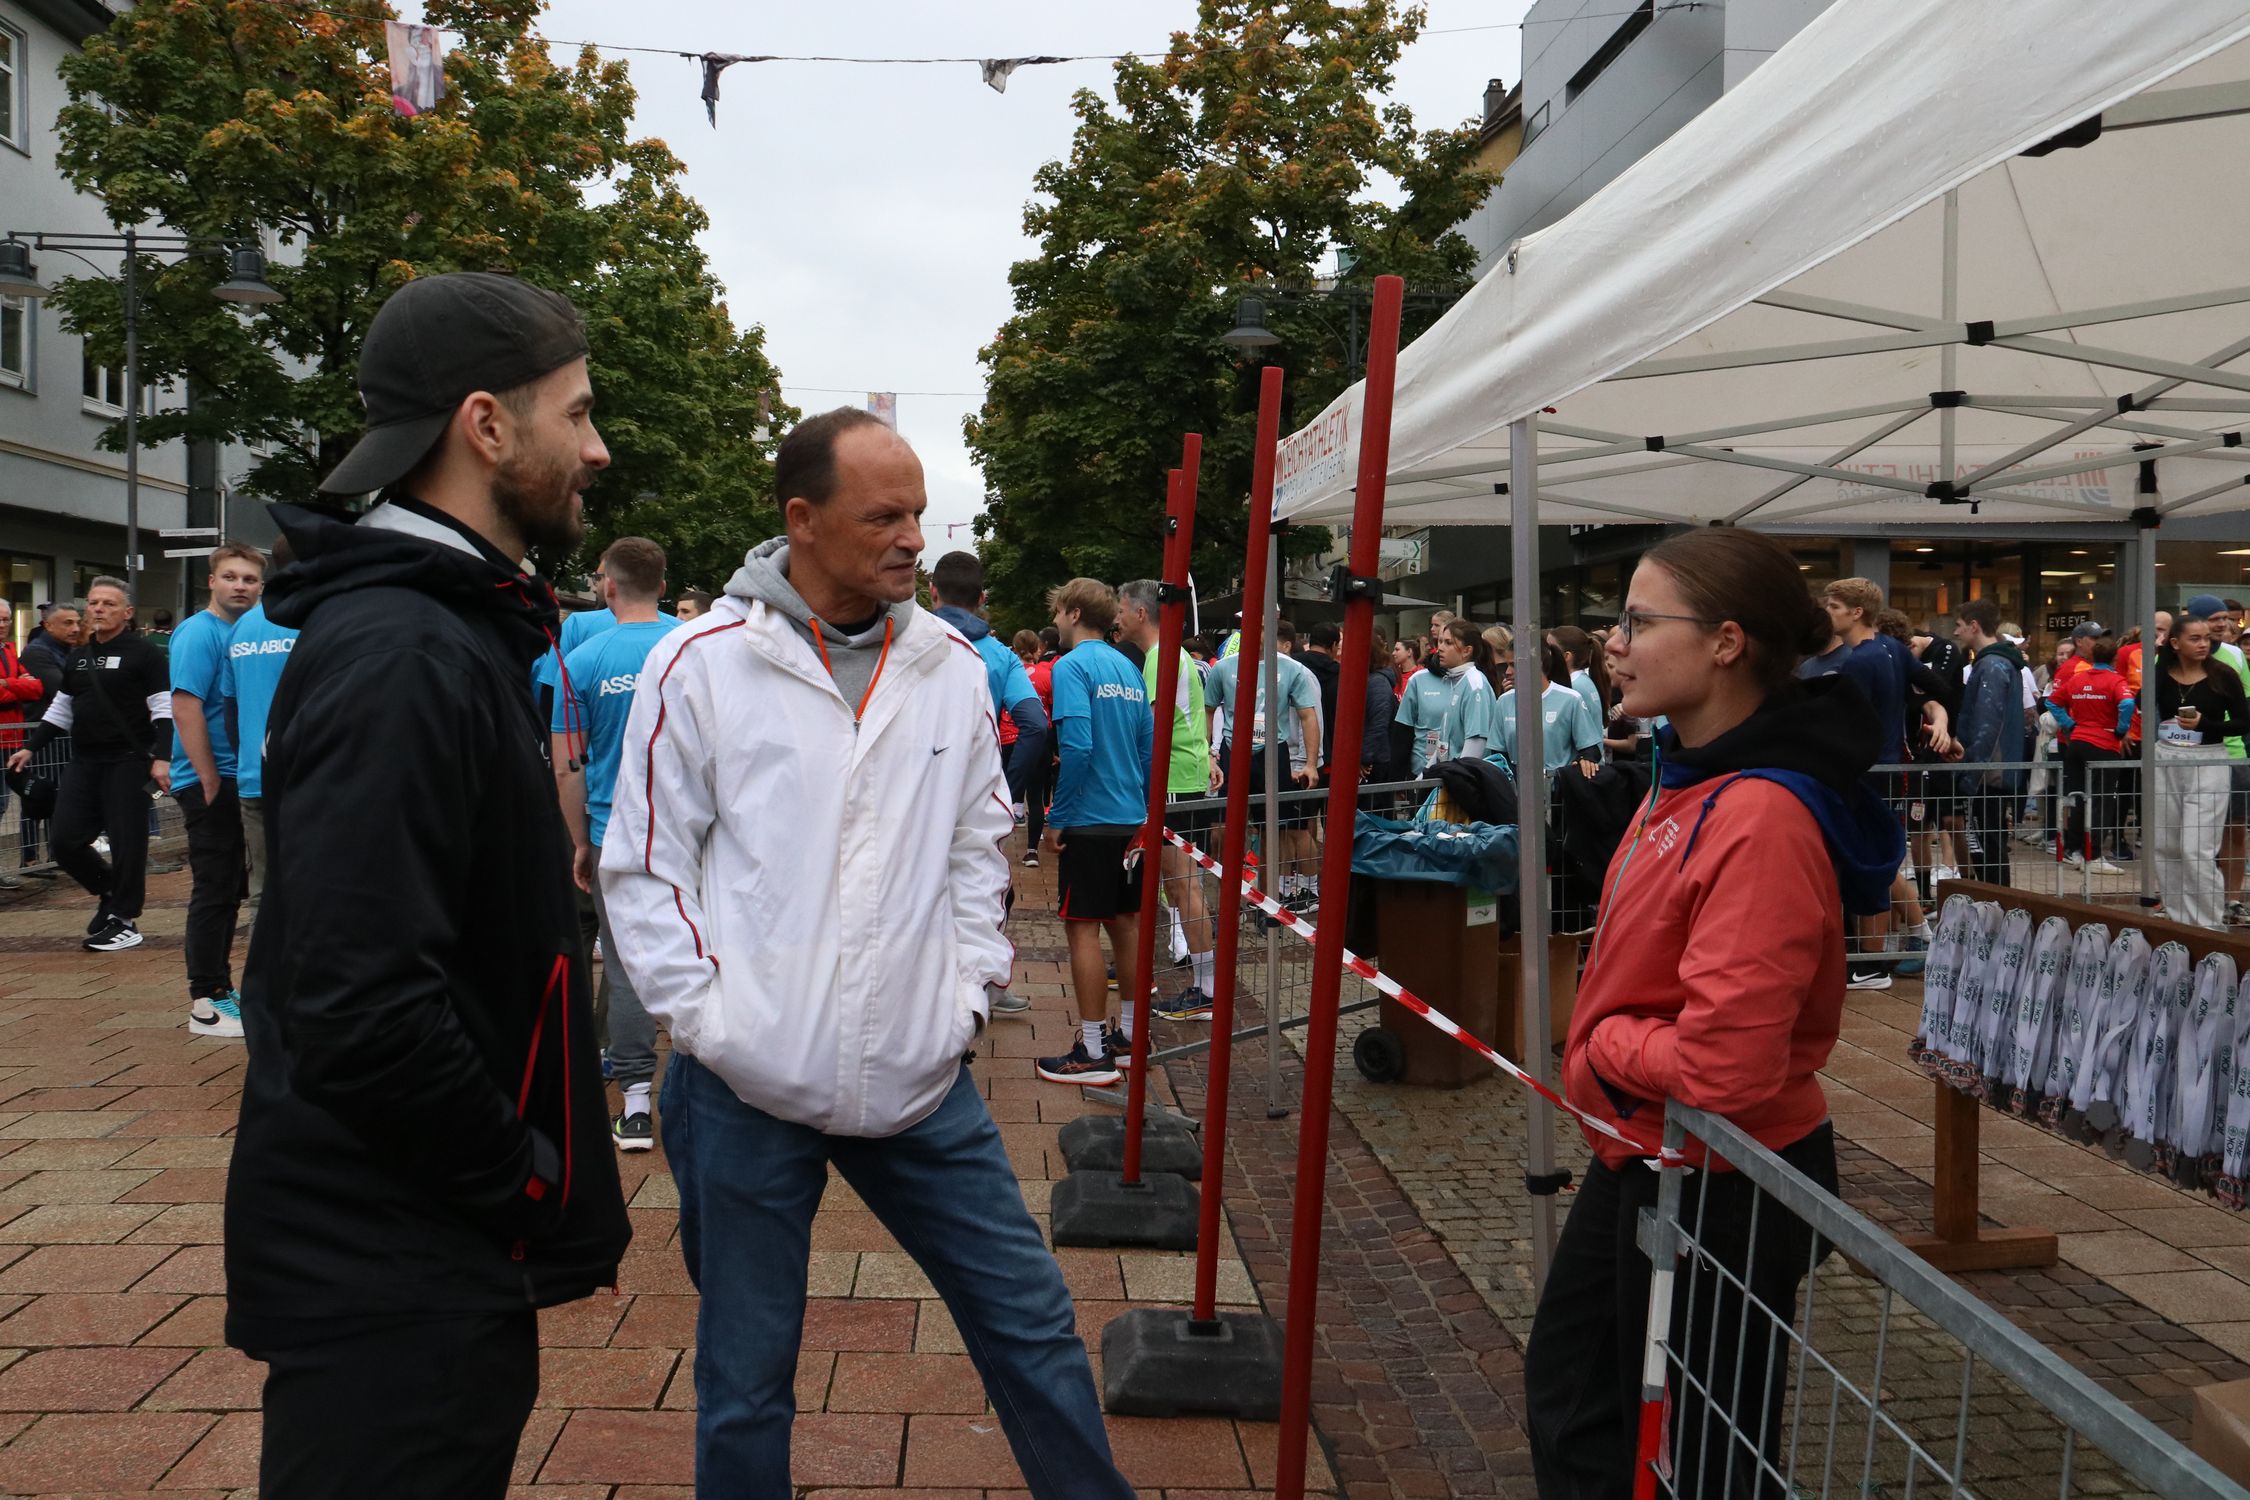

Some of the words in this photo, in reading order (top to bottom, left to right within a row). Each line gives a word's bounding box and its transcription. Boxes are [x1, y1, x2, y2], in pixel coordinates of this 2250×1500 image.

[1283, 402, 1352, 479] LEICHTATHLETIK
[2049, 617, 2066, 628] EYE
[230, 641, 258, 657] SSA
[1096, 683, 1124, 699] ASSA
[2167, 732, 2190, 741] Josi
[2009, 952, 2017, 968] AOK
[2040, 959, 2048, 975] AOK
[2179, 989, 2188, 1009] AOK
[2200, 998, 2208, 1016] AOK
[2226, 996, 2235, 1016] AOK
[1960, 1031, 1969, 1049] AOK
[2156, 1035, 2165, 1054] AOK
[2064, 1057, 2073, 1074] AOK
[2221, 1056, 2230, 1076] AOK
[2216, 1114, 2226, 1136] AOK
[2227, 1137, 2236, 1157] AOK
